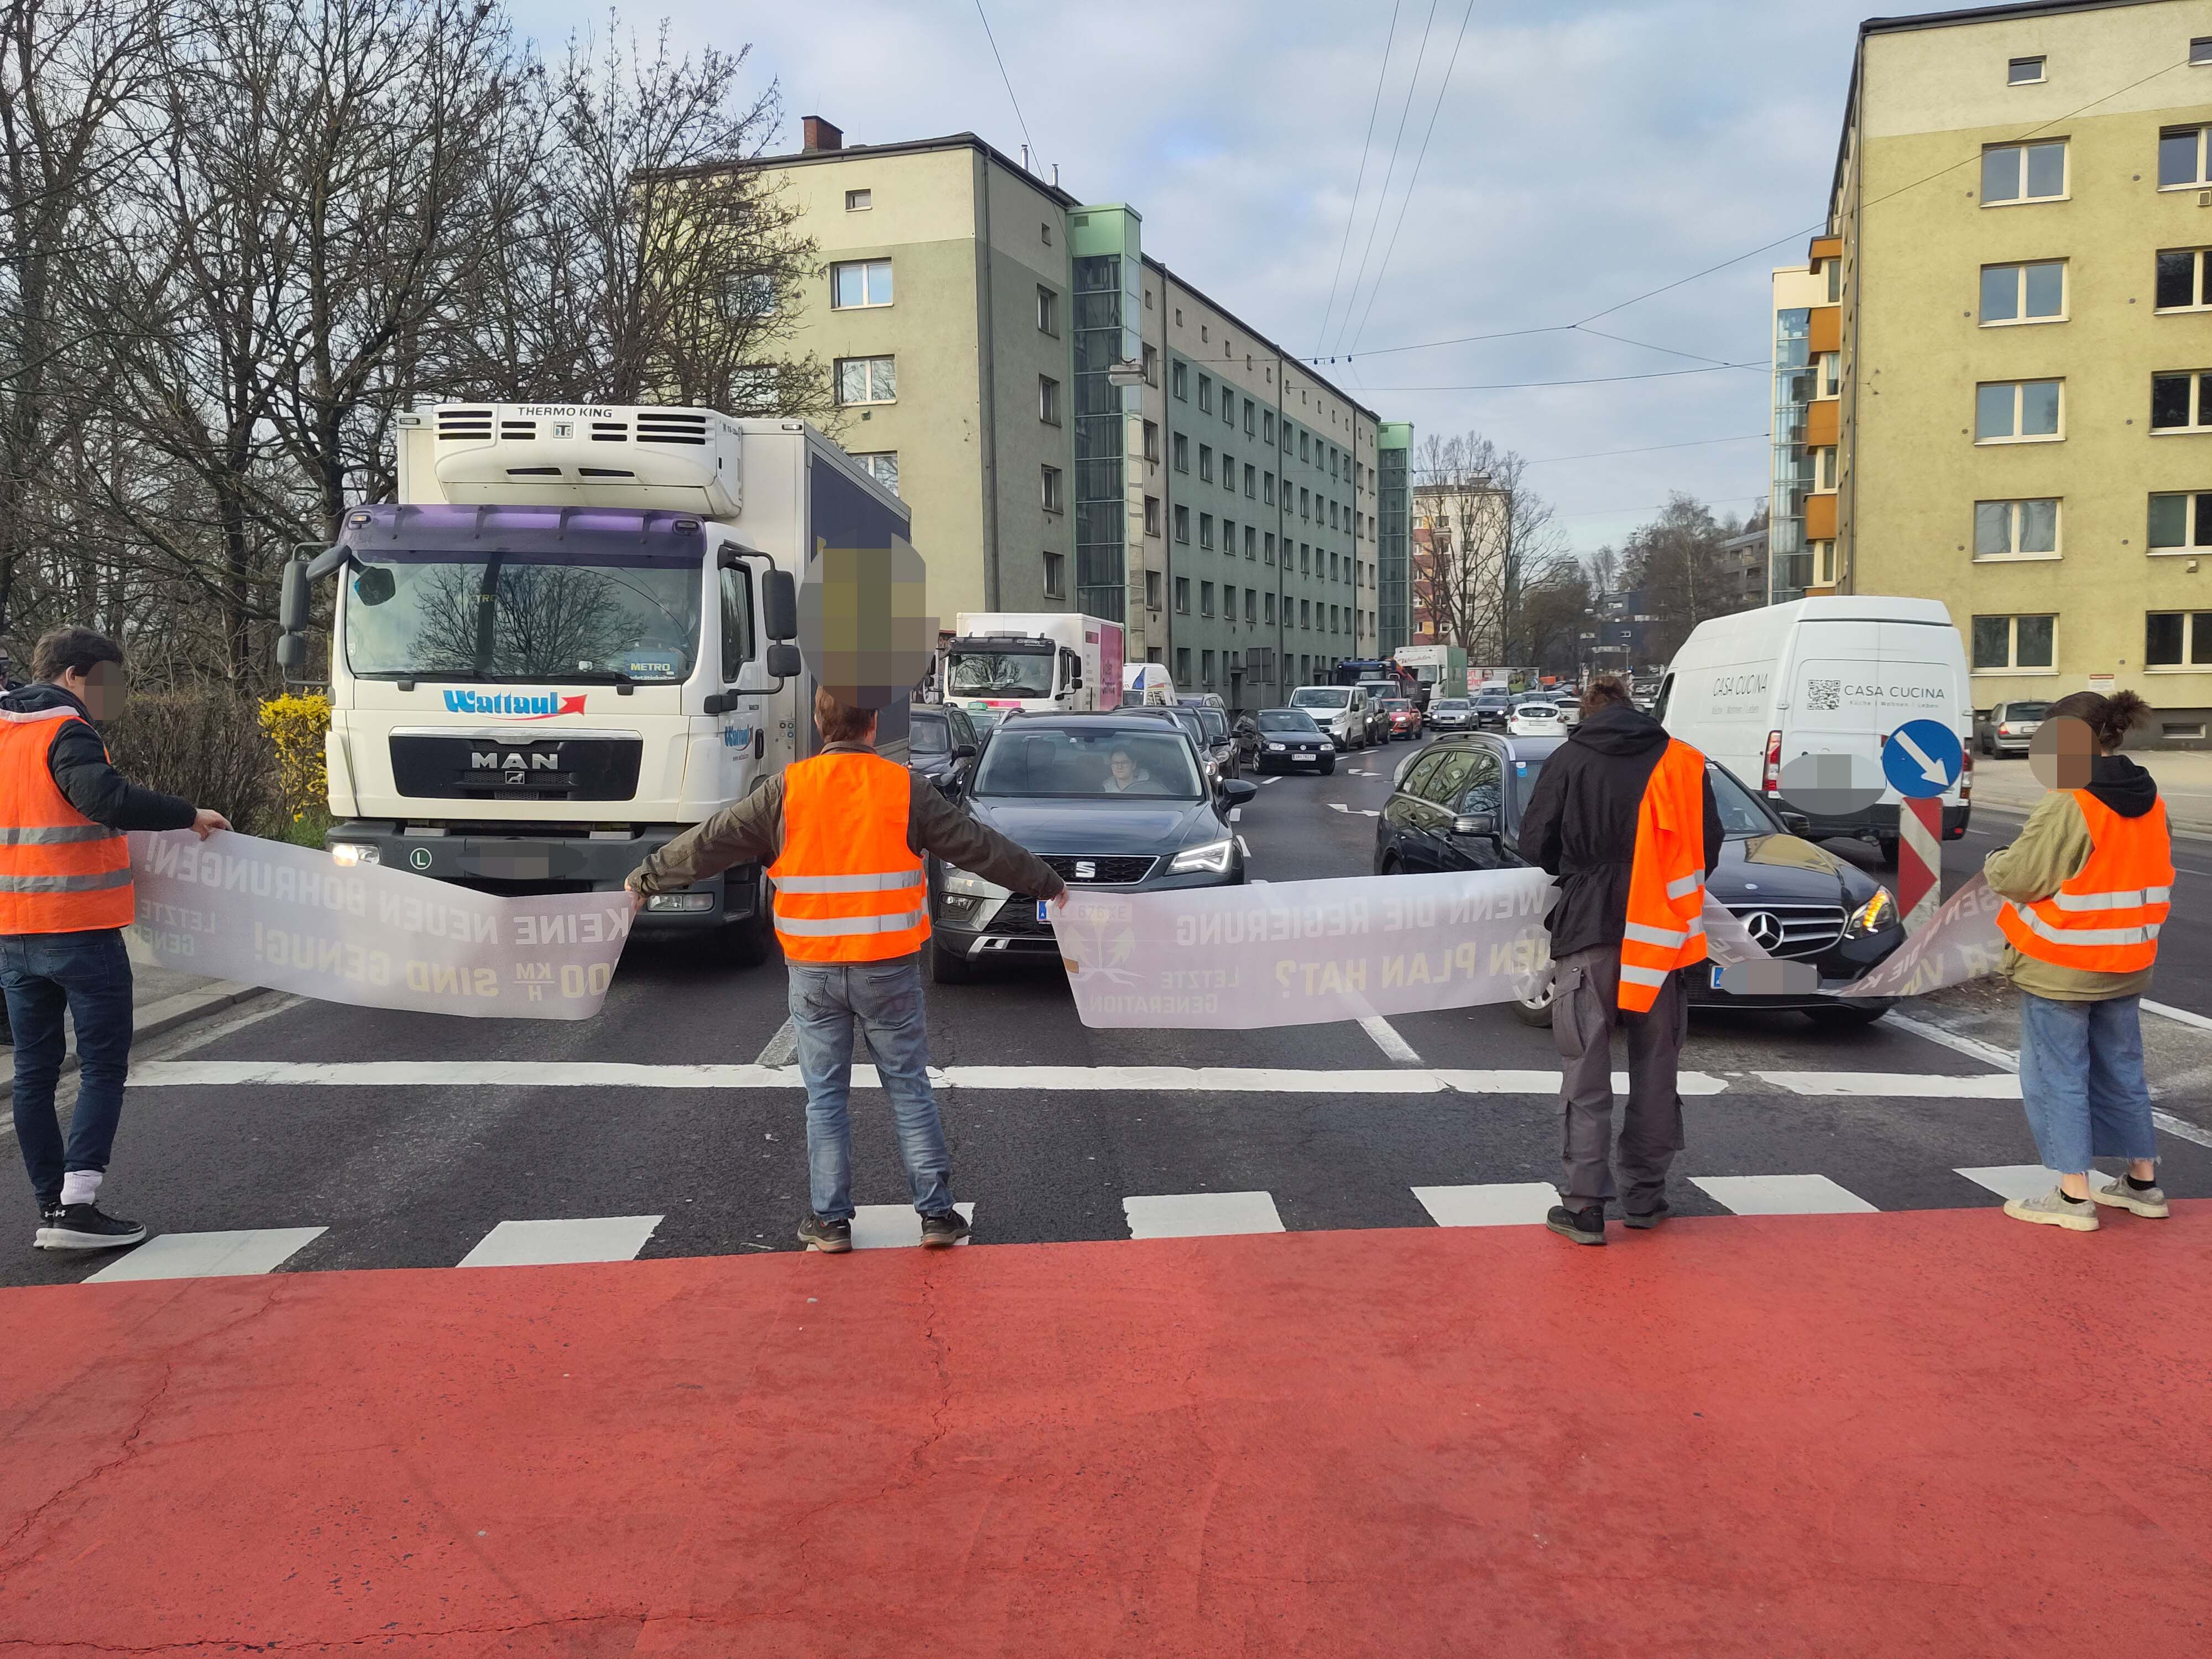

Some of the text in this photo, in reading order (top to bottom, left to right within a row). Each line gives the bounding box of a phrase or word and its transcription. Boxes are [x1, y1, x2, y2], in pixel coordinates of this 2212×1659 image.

[518, 407, 613, 418] THERMO KING
[1713, 677, 1734, 696] CASA
[1844, 685, 1945, 698] CASA CUCINA
[472, 753, 558, 769] MAN
